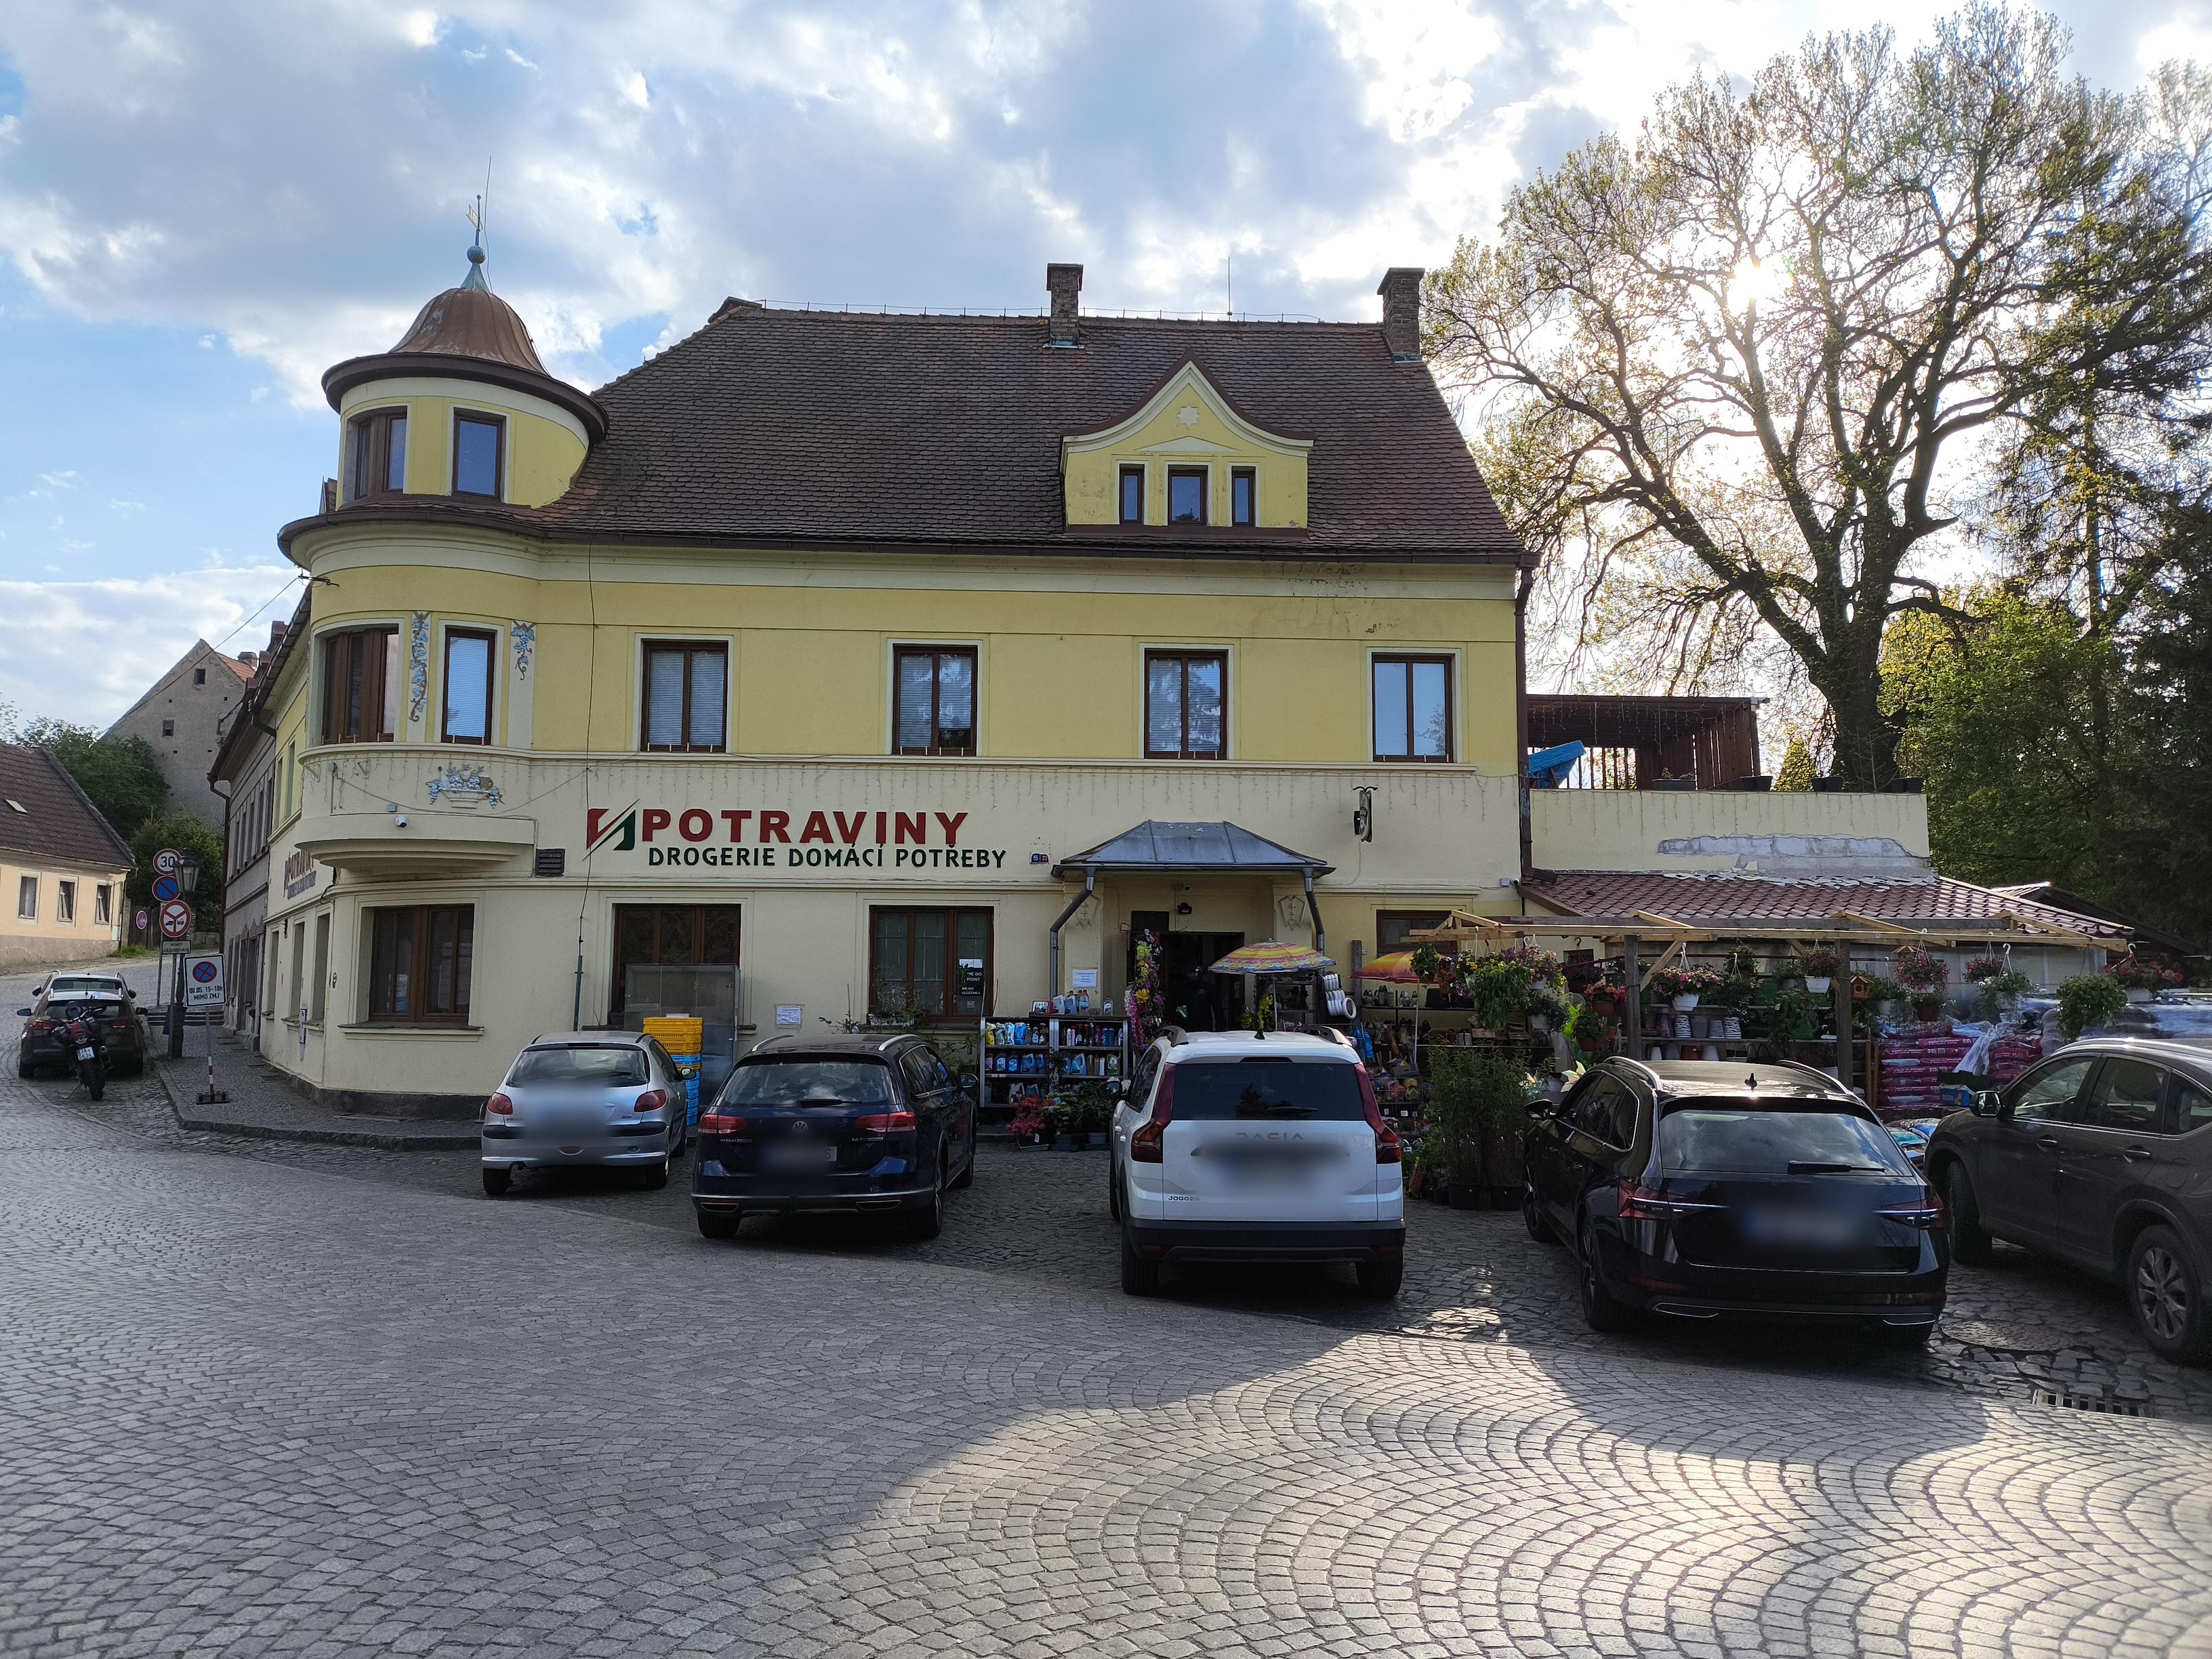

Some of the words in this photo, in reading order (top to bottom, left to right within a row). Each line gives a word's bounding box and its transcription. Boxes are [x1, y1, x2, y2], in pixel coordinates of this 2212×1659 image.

[641, 808, 969, 845] POTRAVINY
[160, 856, 176, 868] 30
[648, 846, 775, 867] DROGERIE
[788, 842, 884, 867] DOMÁCÍ
[895, 843, 1007, 868] POTŘEBY
